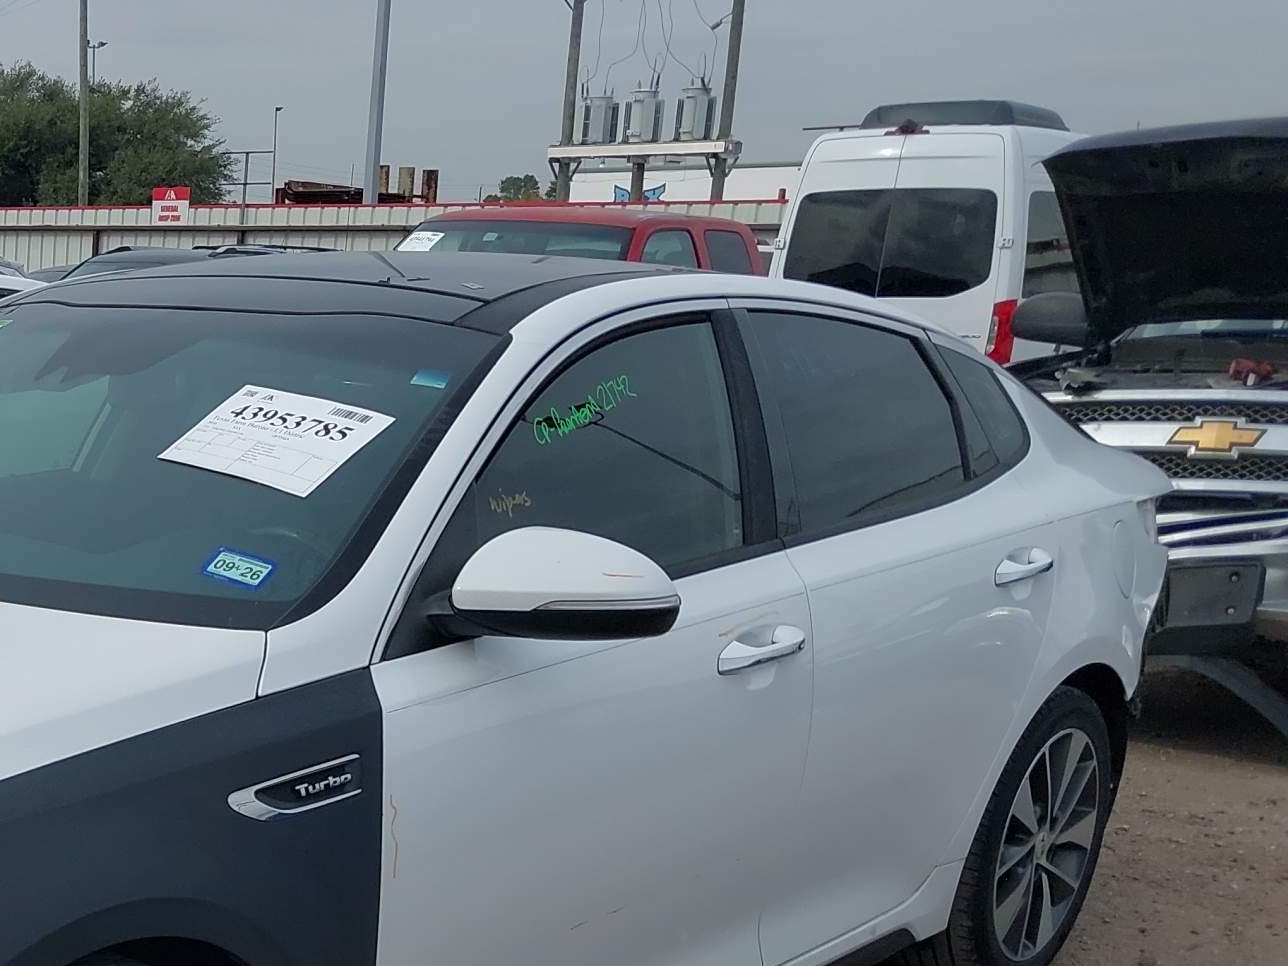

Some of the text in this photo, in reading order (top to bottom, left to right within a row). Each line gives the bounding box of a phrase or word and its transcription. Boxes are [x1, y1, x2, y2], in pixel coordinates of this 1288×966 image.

[229, 404, 356, 442] 43953785
[213, 558, 264, 581] 09 26
[294, 772, 352, 797] Turbo
